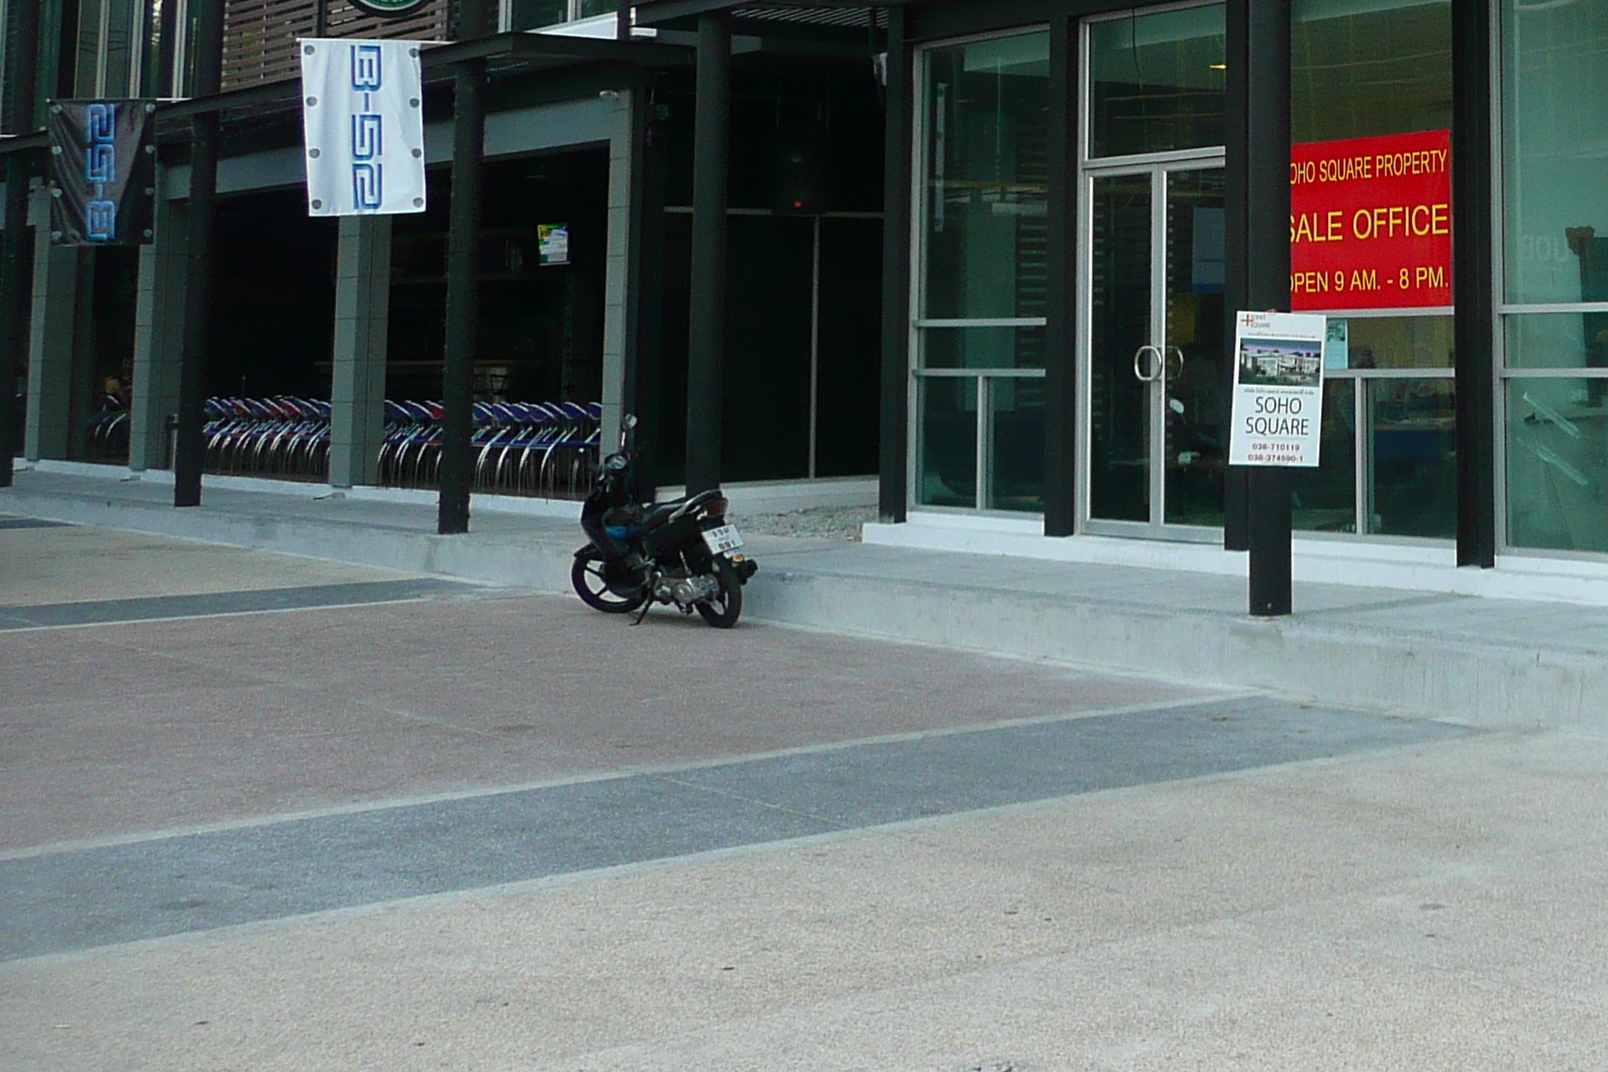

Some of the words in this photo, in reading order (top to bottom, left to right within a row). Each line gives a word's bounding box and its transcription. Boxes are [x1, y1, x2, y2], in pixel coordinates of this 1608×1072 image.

[351, 44, 382, 210] B-52
[87, 103, 115, 240] B-52
[1290, 161, 1316, 185] OHO
[1319, 156, 1372, 182] SQUARE
[1376, 149, 1448, 178] PROPERTY
[1353, 204, 1449, 239] OFFICE
[1290, 271, 1328, 293] PEN
[1334, 270, 1345, 292] 9
[1350, 269, 1381, 291] AM.
[1399, 268, 1410, 290] 8
[1416, 266, 1449, 289] PM.
[1255, 396, 1302, 415] SOHO
[1245, 417, 1309, 436] SQUARE
